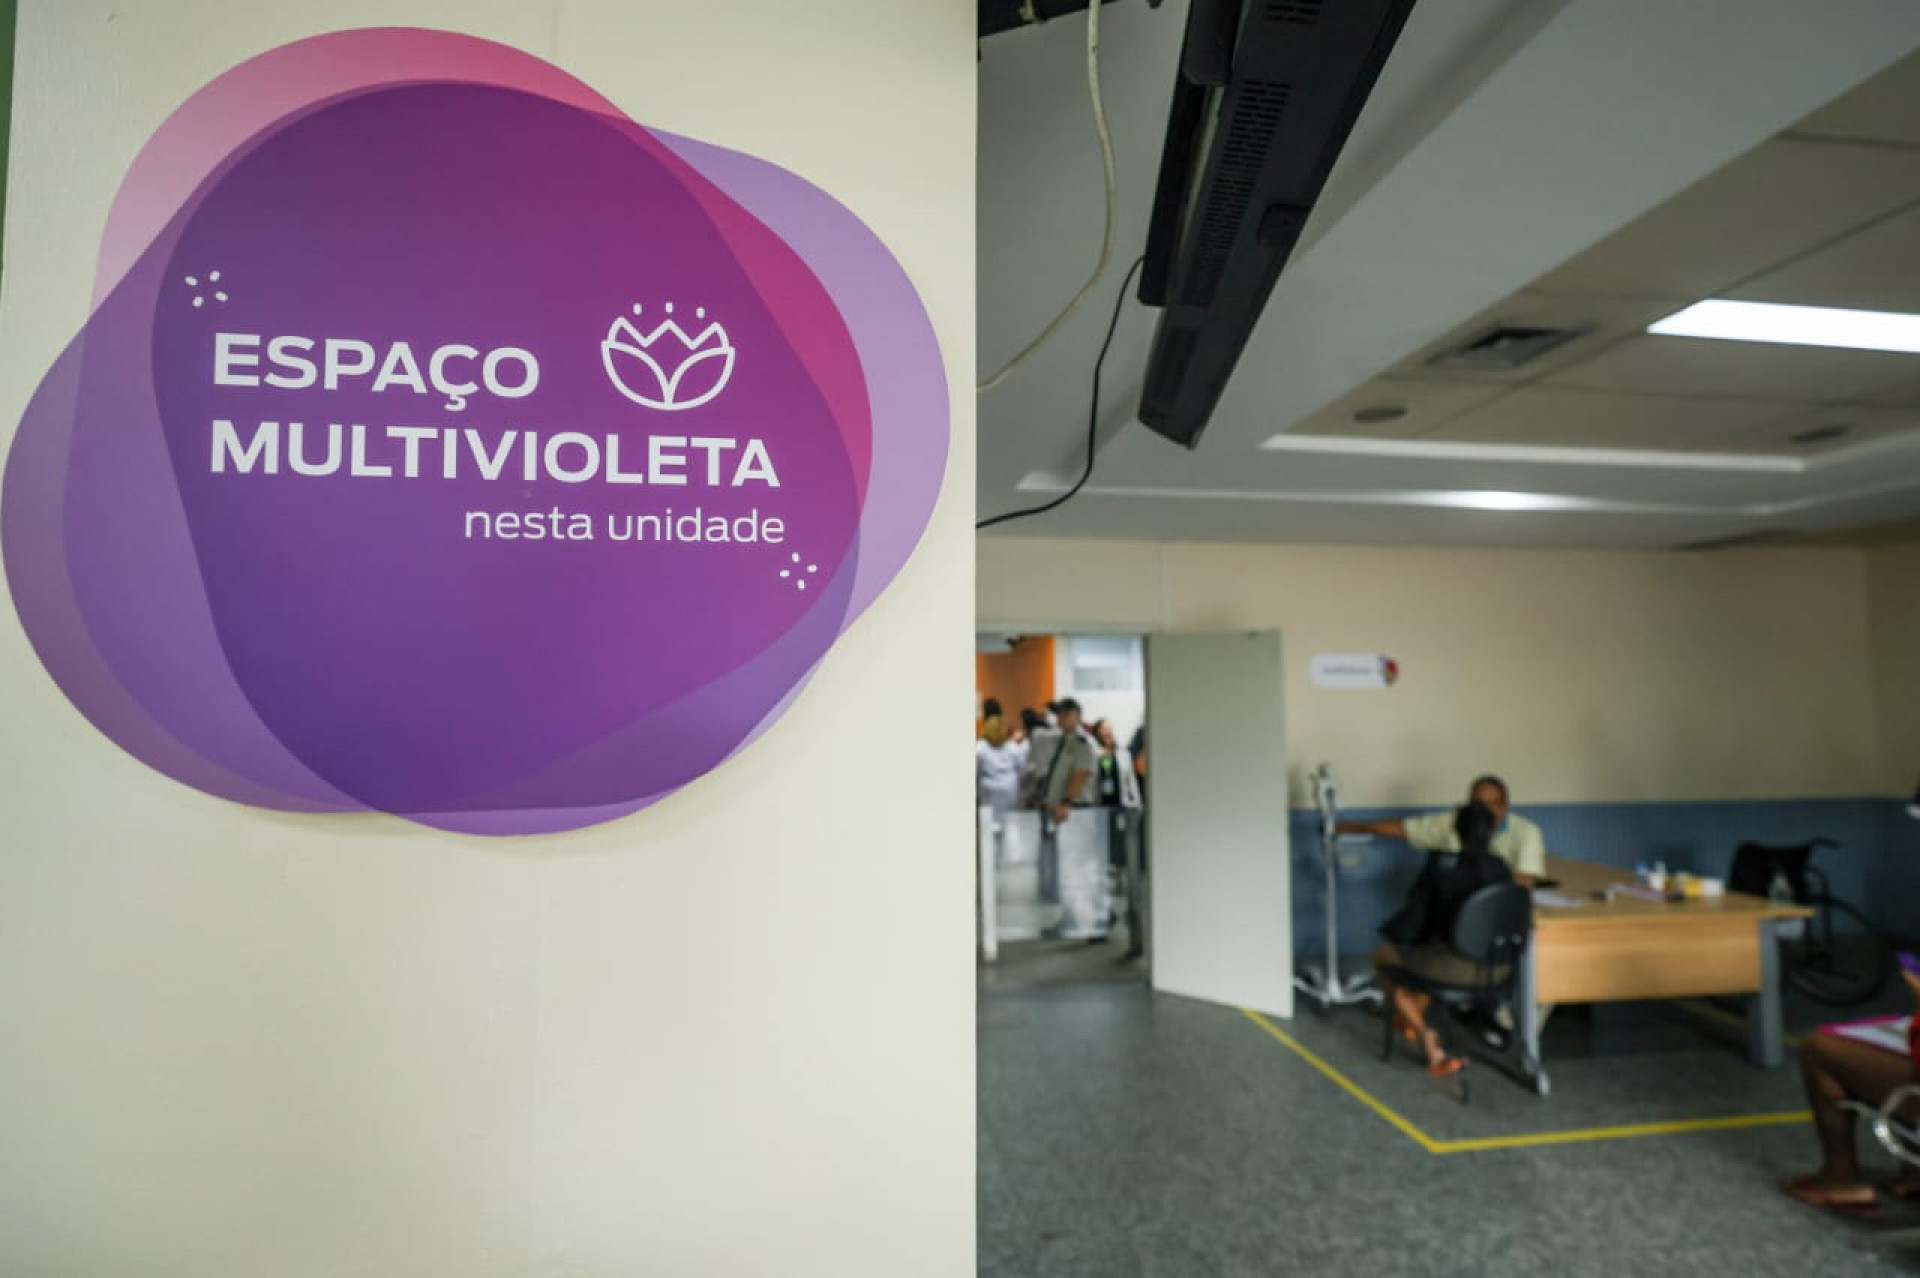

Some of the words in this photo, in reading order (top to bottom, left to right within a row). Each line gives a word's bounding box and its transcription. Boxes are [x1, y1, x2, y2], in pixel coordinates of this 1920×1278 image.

[212, 332, 540, 412] ESPAÇO
[210, 419, 781, 488] MULTIVIOLETA
[464, 506, 594, 541] nesta
[607, 508, 786, 544] unidade
